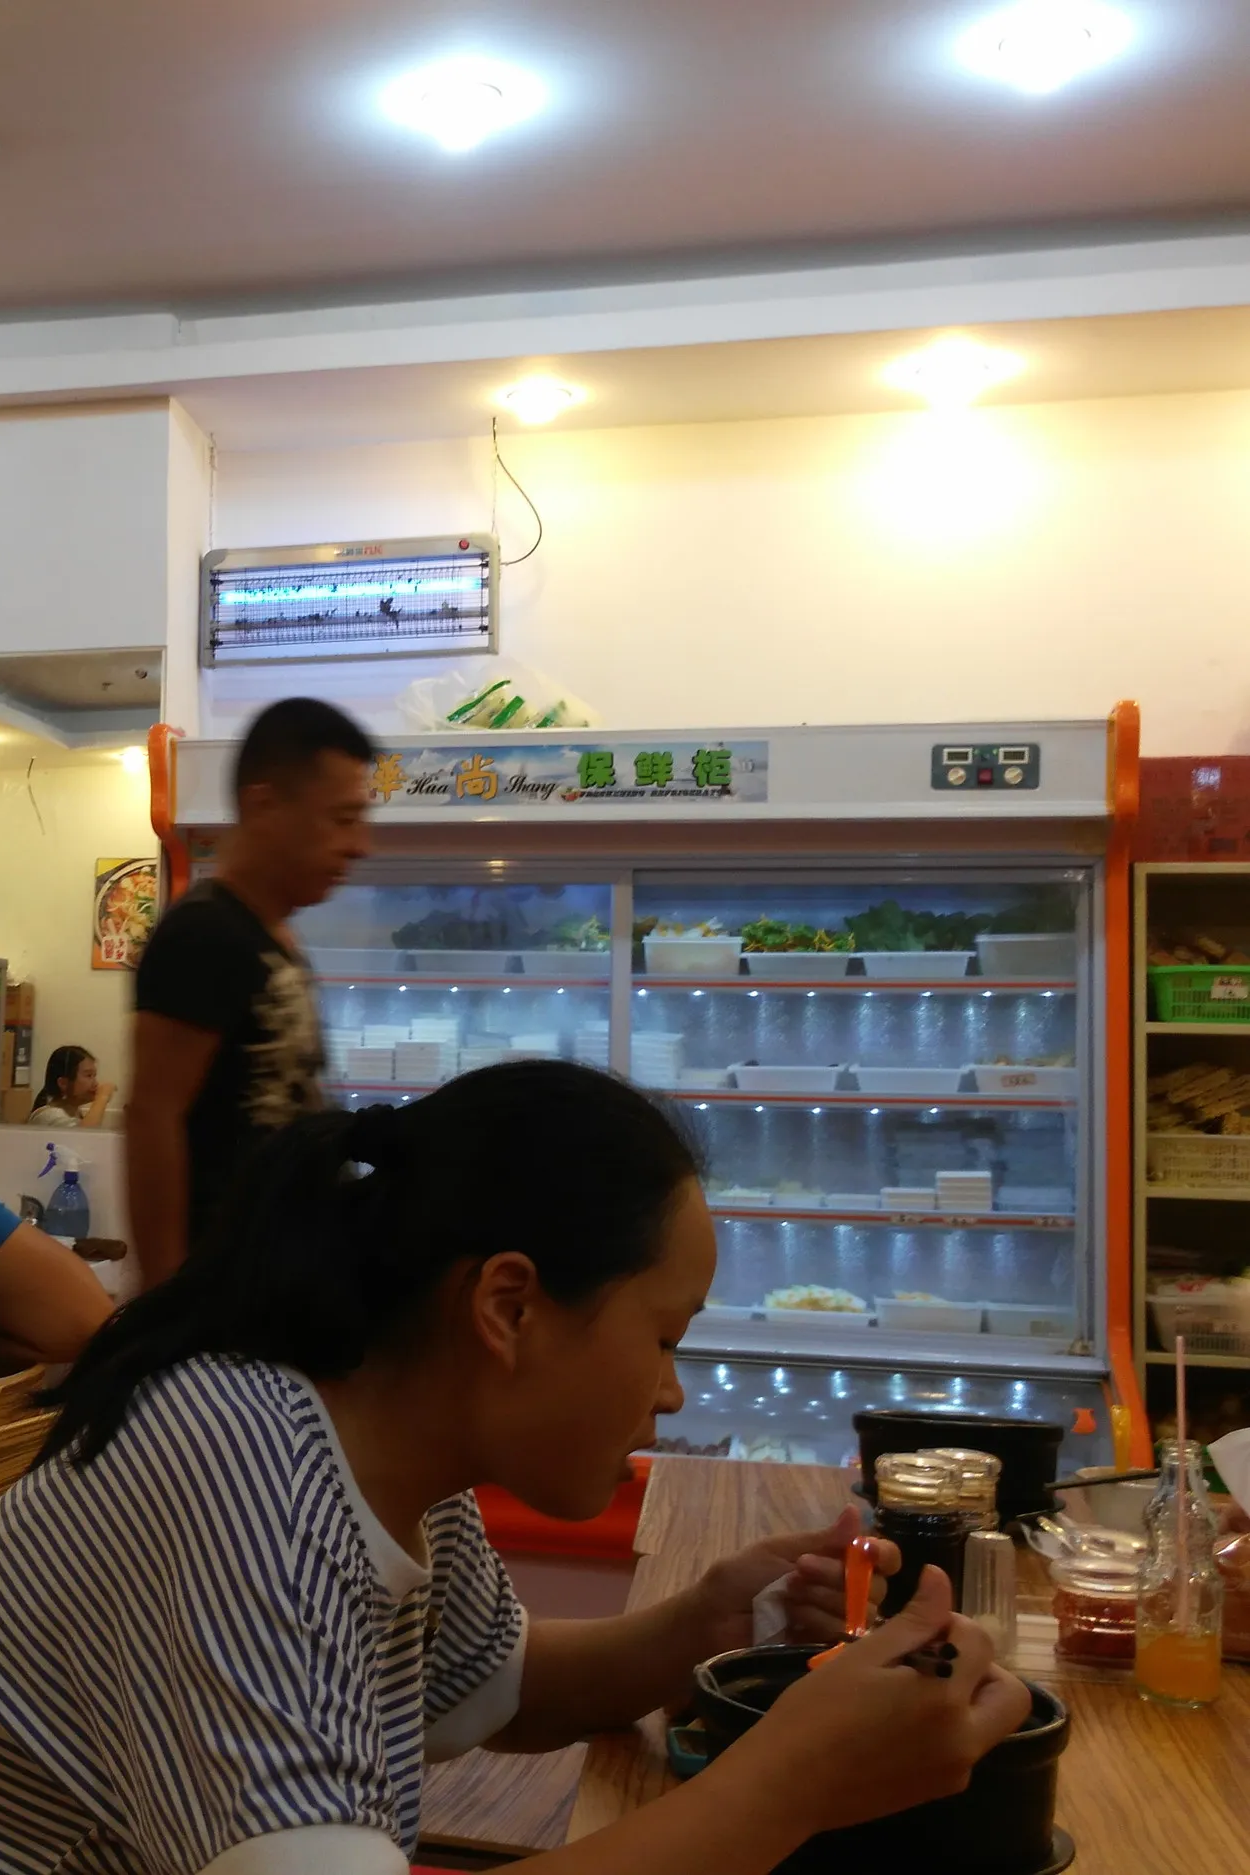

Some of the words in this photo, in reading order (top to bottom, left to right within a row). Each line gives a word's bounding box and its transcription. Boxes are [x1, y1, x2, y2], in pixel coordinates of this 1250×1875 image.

[456, 753, 500, 800] 尚
[577, 750, 733, 788] 保鲜柜
